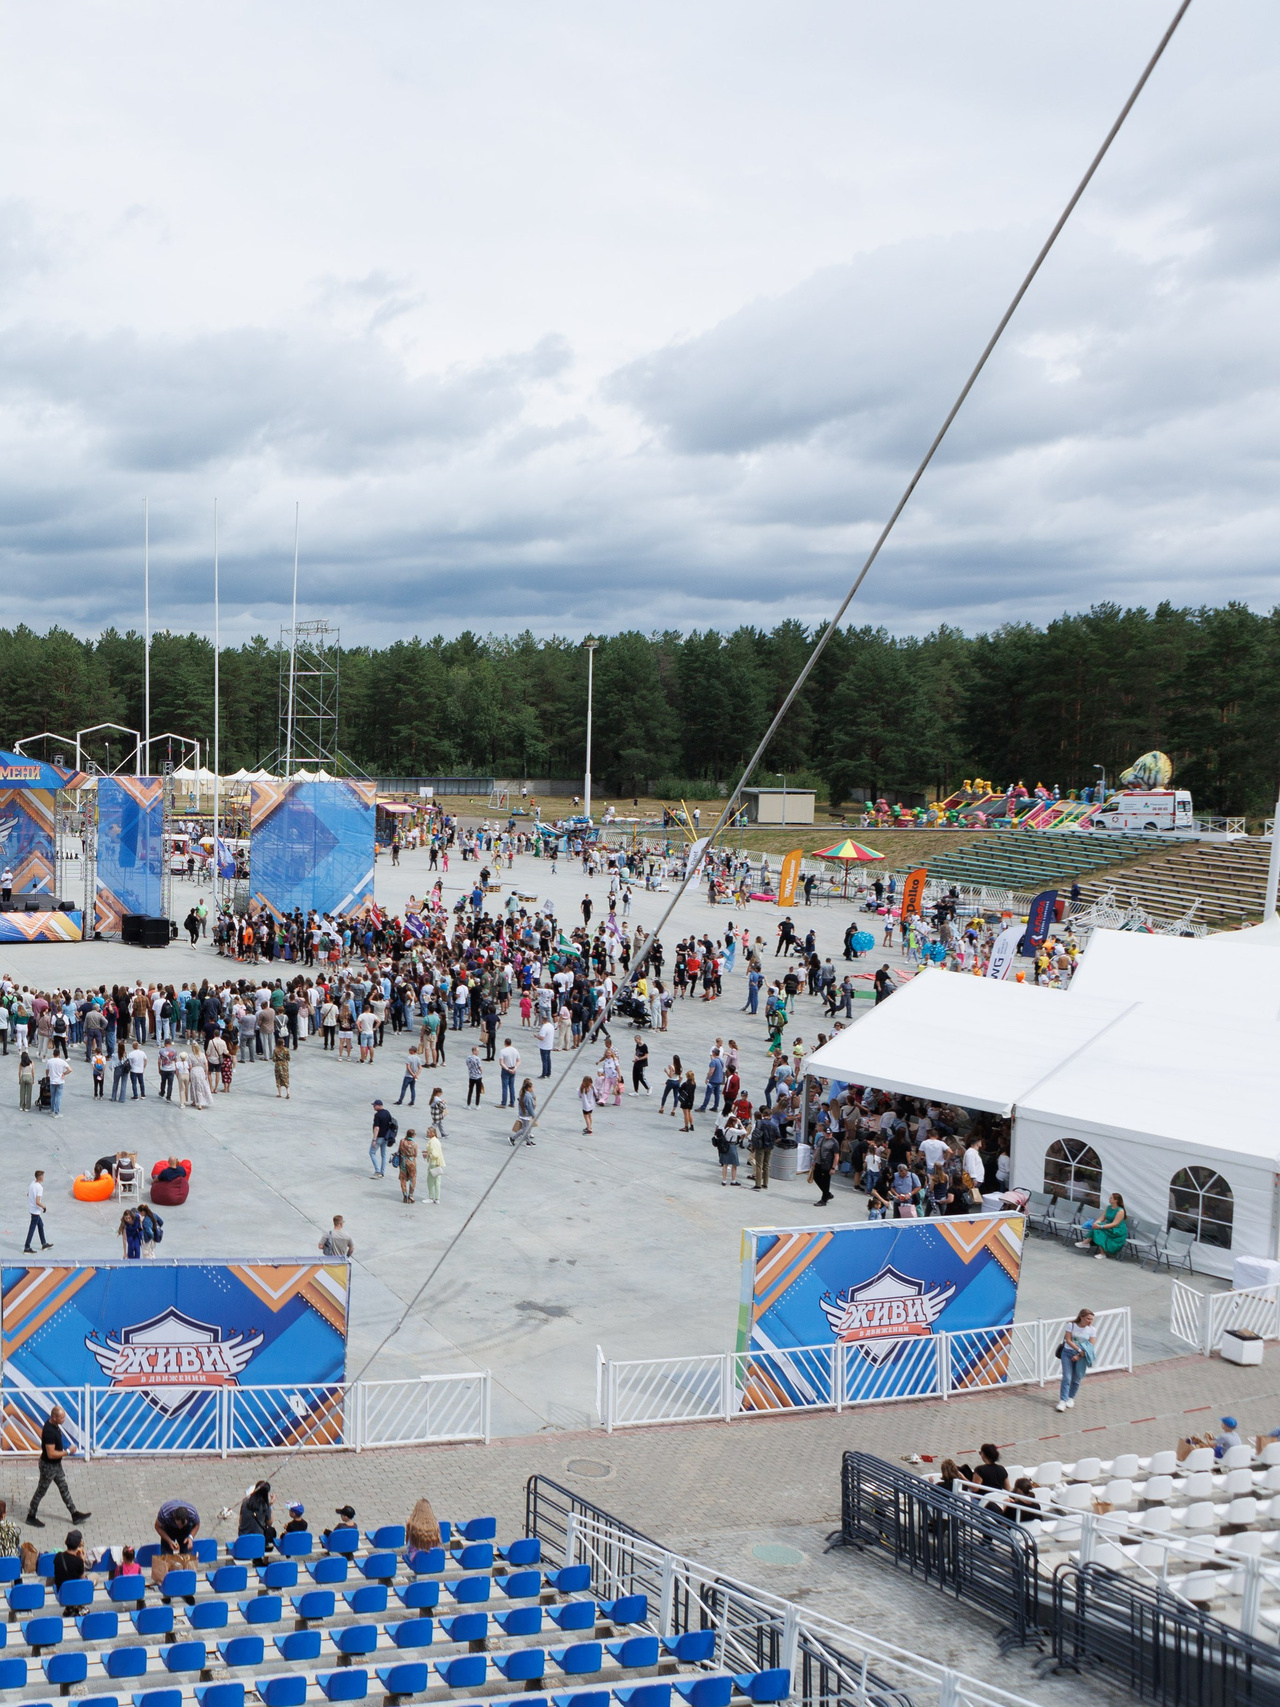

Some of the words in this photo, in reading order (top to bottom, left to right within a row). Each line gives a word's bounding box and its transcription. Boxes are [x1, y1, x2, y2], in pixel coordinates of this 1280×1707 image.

[906, 879, 919, 913] Delko
[1034, 900, 1047, 933] АЛЬФА
[839, 1298, 927, 1330] ЖИВИ
[865, 1326, 909, 1336] ДВИЖЕНИИ
[114, 1346, 230, 1373] ЖИВИ
[149, 1375, 206, 1383] ДВИЖЕНИИ
